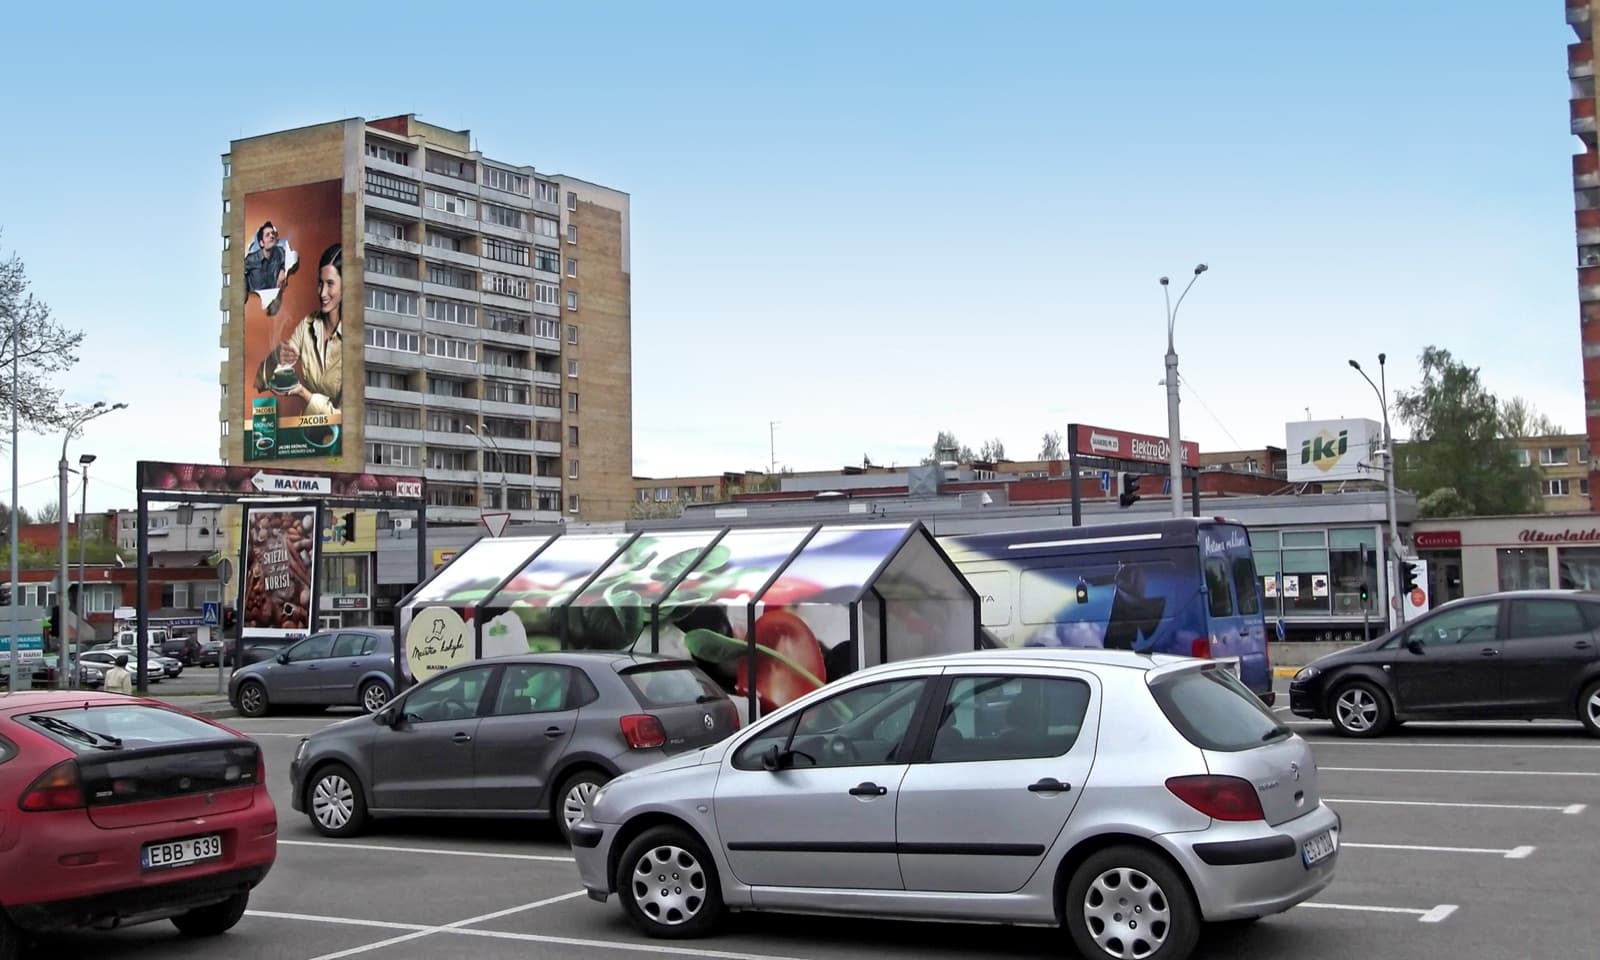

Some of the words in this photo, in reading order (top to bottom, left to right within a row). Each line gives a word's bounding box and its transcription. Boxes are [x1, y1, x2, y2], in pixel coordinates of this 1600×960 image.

[299, 416, 328, 425] JACOBS
[1301, 430, 1348, 465] iki
[274, 478, 320, 491] MAXIMA
[1518, 528, 1600, 542] Užuolaid
[150, 844, 184, 864] EBB
[193, 838, 219, 857] 639
